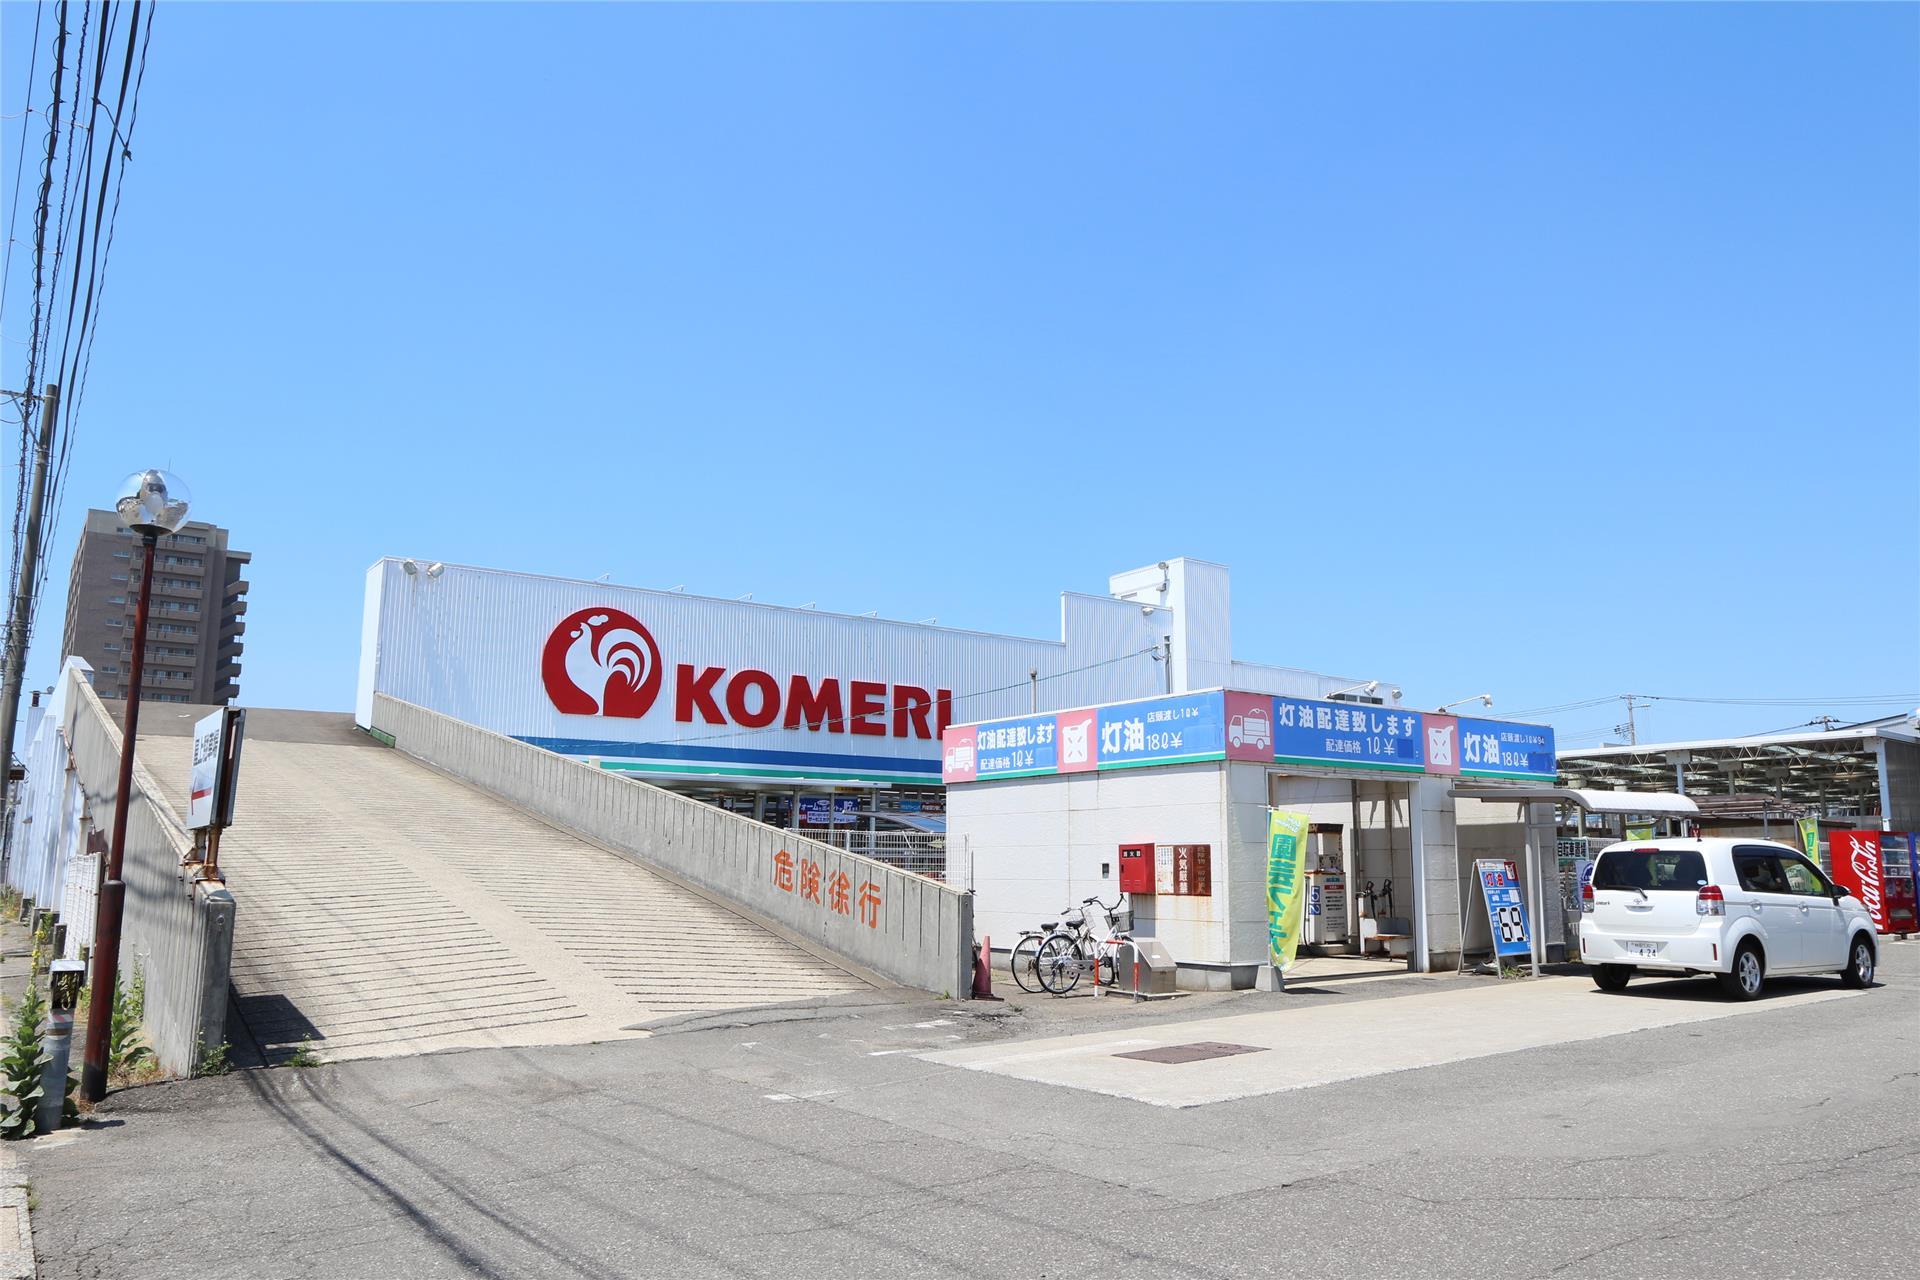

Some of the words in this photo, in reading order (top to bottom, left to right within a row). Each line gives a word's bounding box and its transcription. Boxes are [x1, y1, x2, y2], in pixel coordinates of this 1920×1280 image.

[675, 664, 952, 741] KOMERI
[1280, 702, 1416, 737] 灯油配達致します
[977, 722, 1056, 751] 灯油配達致します
[1101, 717, 1145, 755] 灯油
[1325, 738, 1362, 754] 配達価格
[1463, 731, 1500, 765] 灯油
[1178, 847, 1188, 894] 火気厳禁
[1849, 834, 1884, 930] oca-Cola
[774, 849, 881, 929] 危険徐行
[1499, 907, 1525, 942] 69
